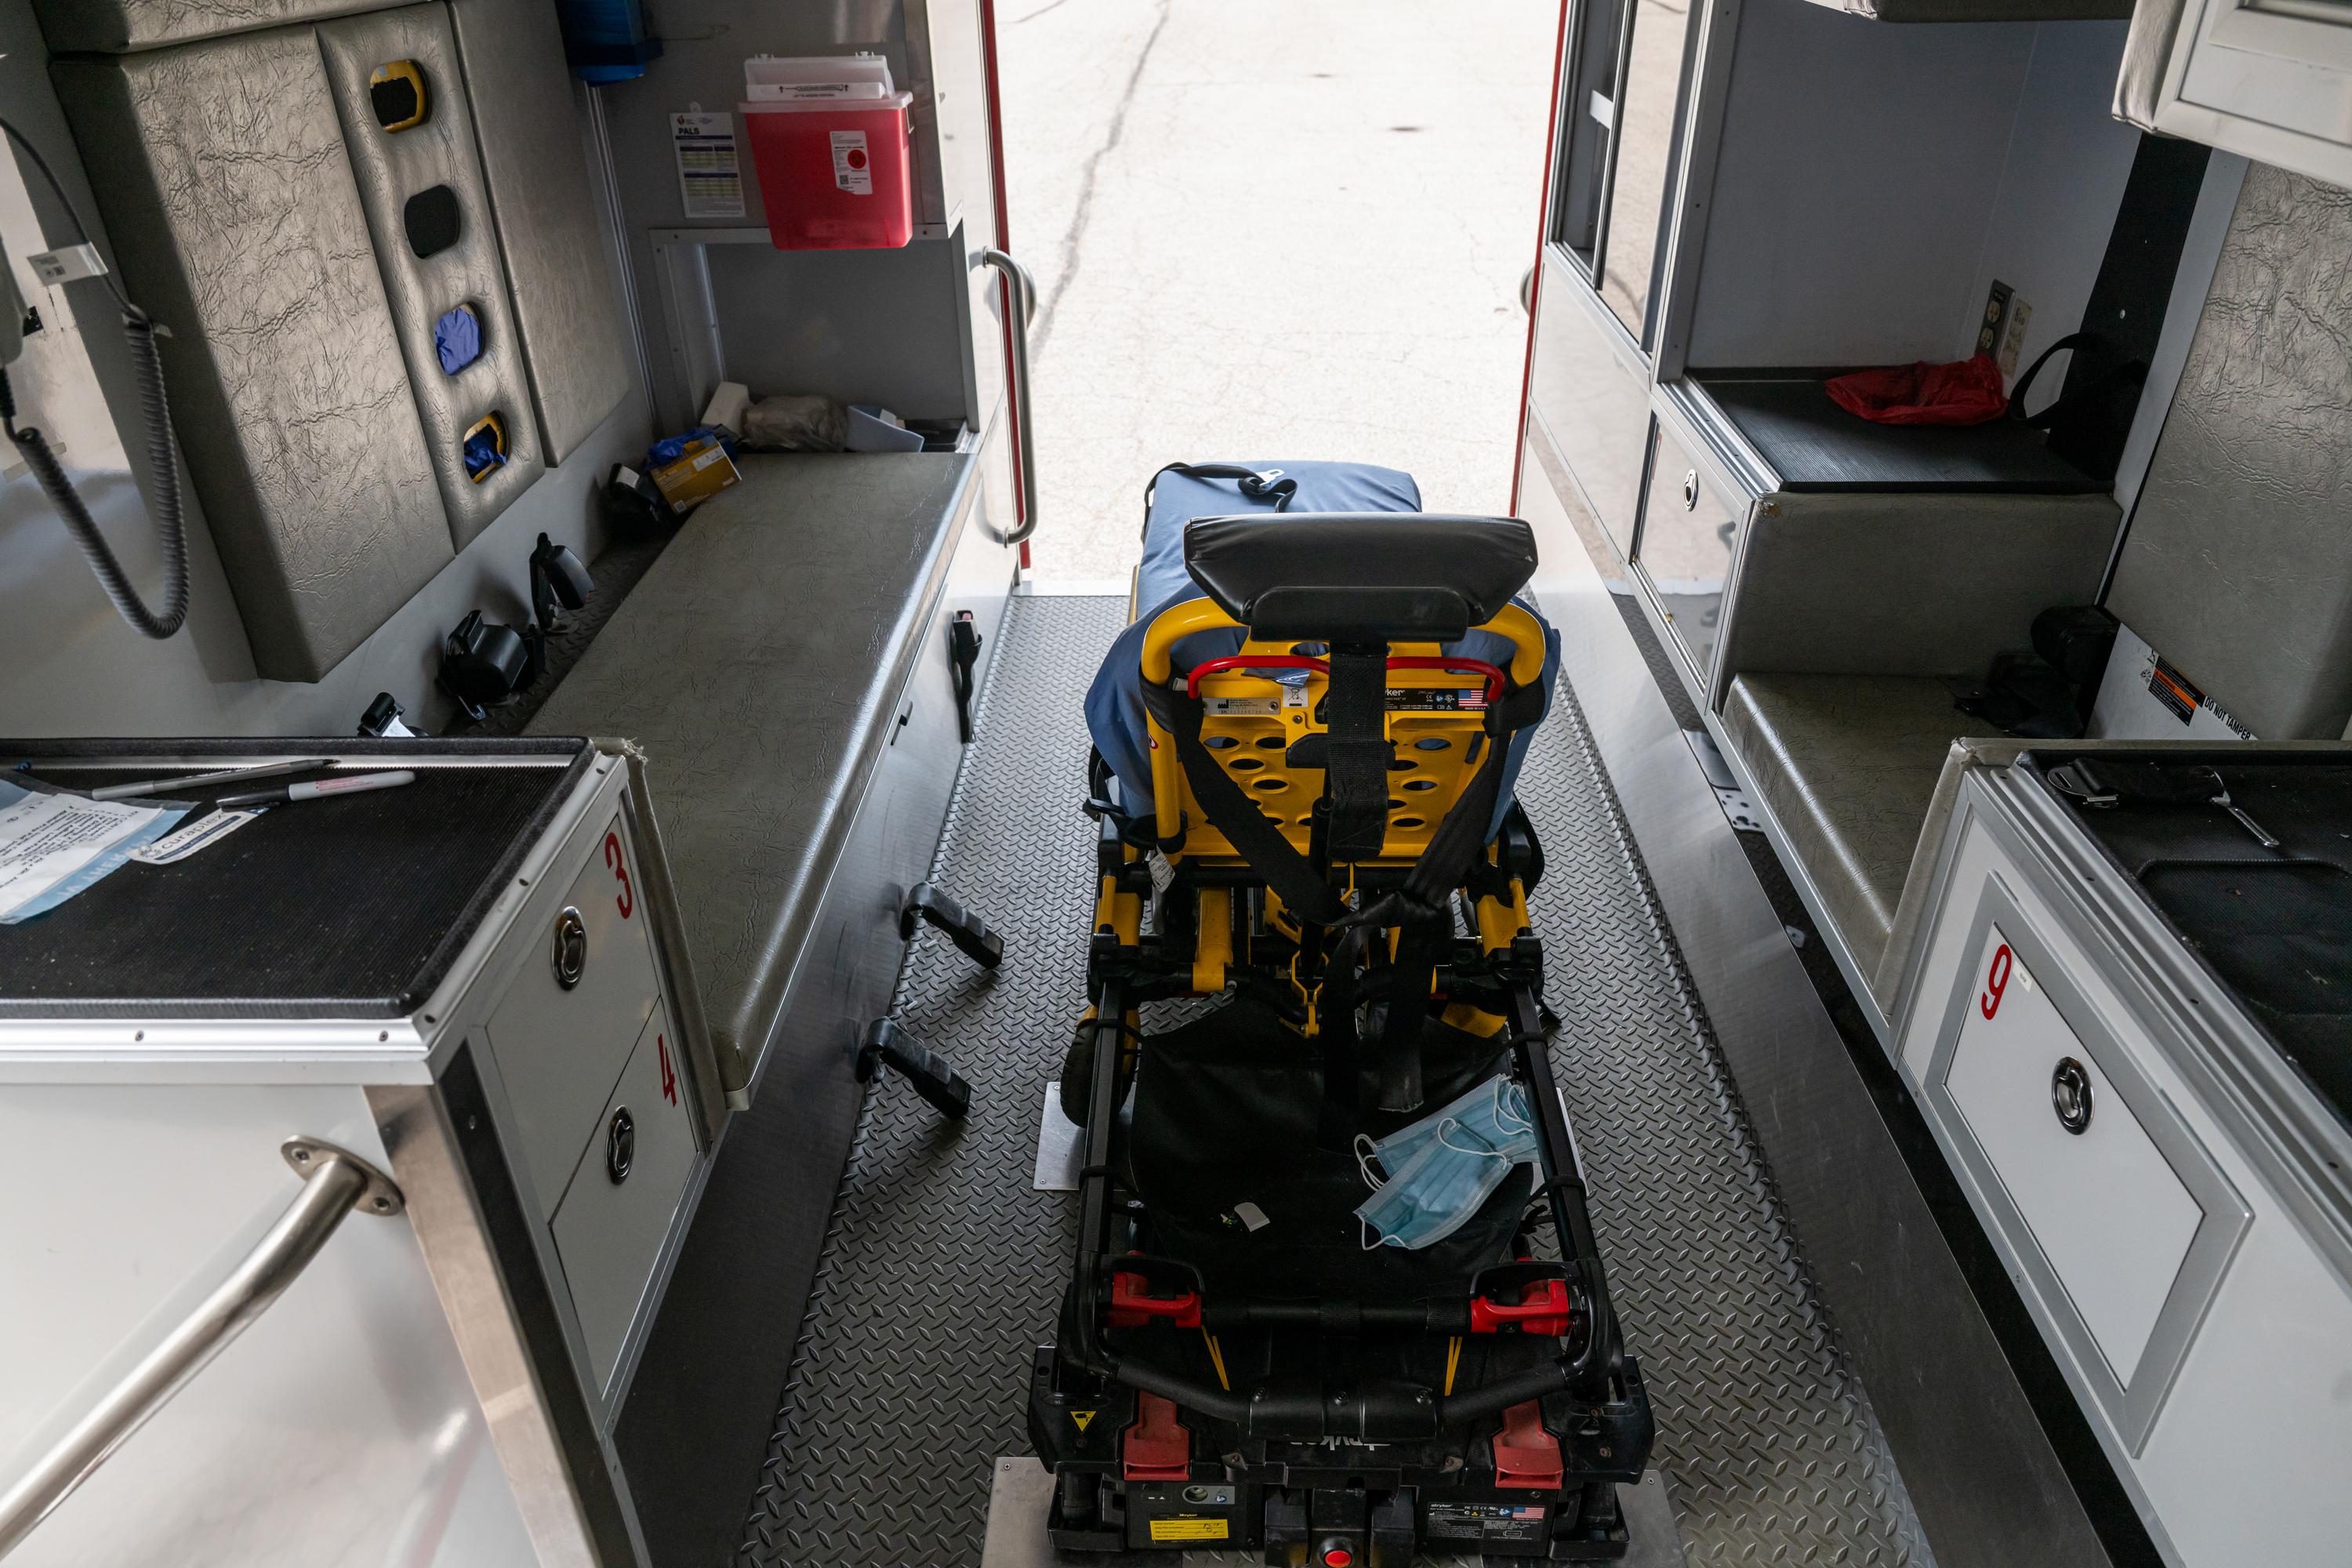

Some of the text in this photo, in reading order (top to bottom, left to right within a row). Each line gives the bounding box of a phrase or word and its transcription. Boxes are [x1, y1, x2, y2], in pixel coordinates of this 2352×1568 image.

[2205, 697, 2251, 740] DO NOT TAMPER
[162, 813, 223, 849] curaplex
[605, 833, 632, 919] 3
[1981, 944, 2012, 1020] 9
[657, 1033, 677, 1107] 4
